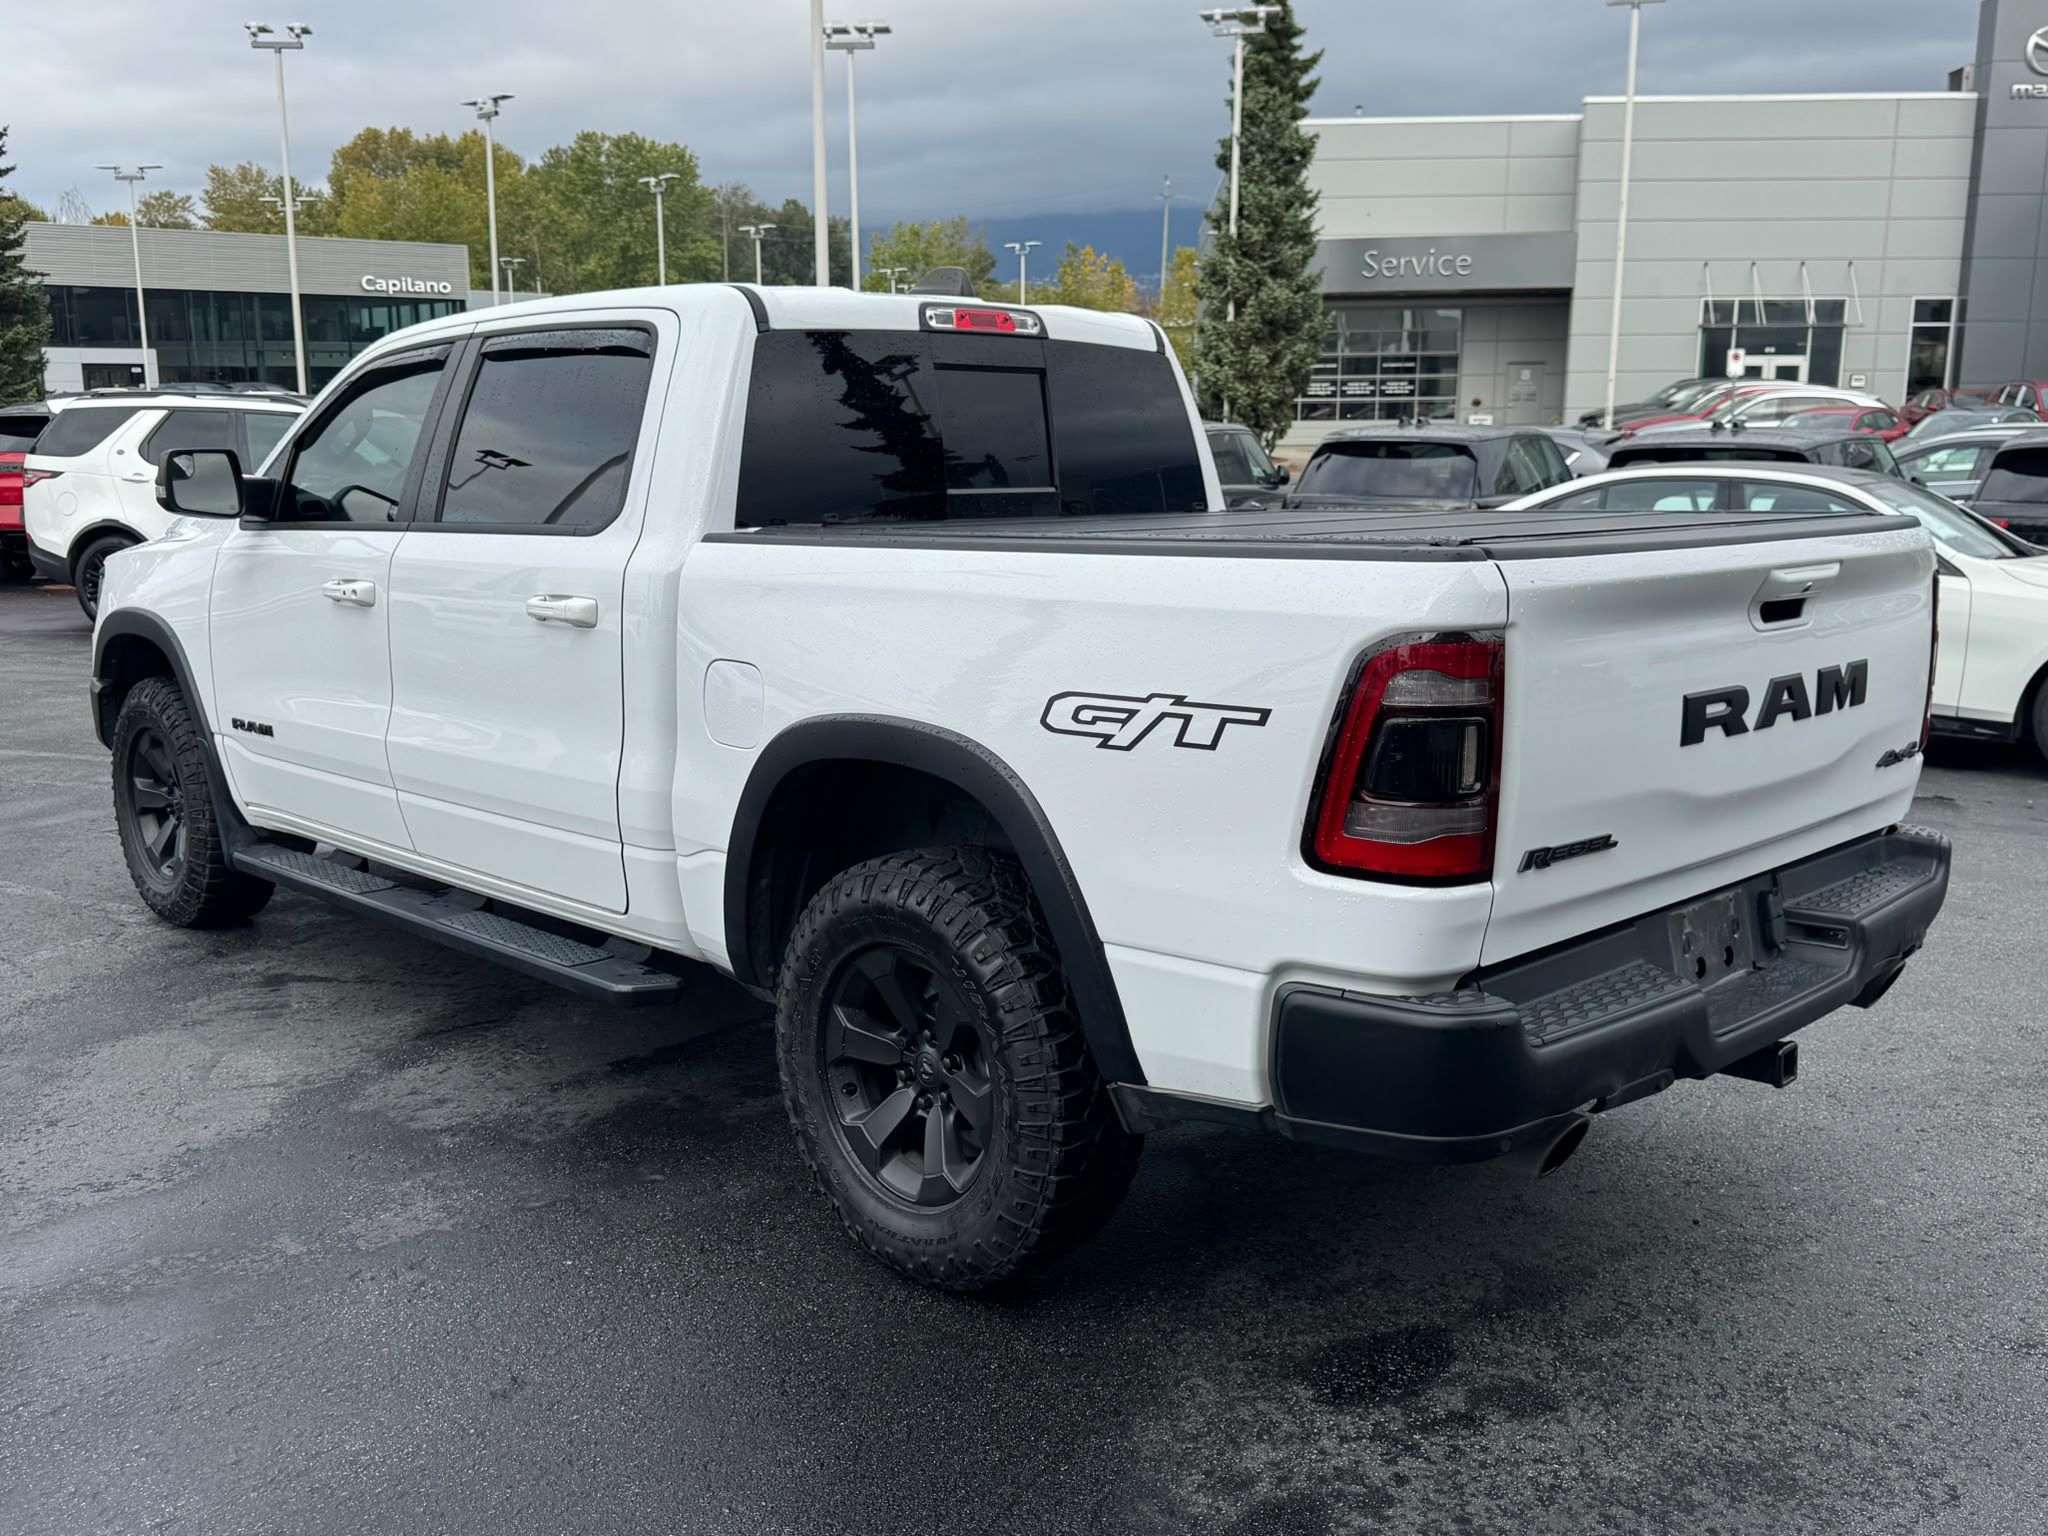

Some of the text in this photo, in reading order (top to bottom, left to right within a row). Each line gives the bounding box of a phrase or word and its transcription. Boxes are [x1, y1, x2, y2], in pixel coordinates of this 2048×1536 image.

[1361, 247, 1473, 278] Service
[361, 275, 452, 295] Capilano
[1680, 658, 1868, 747] RAM
[231, 717, 274, 738] RAM
